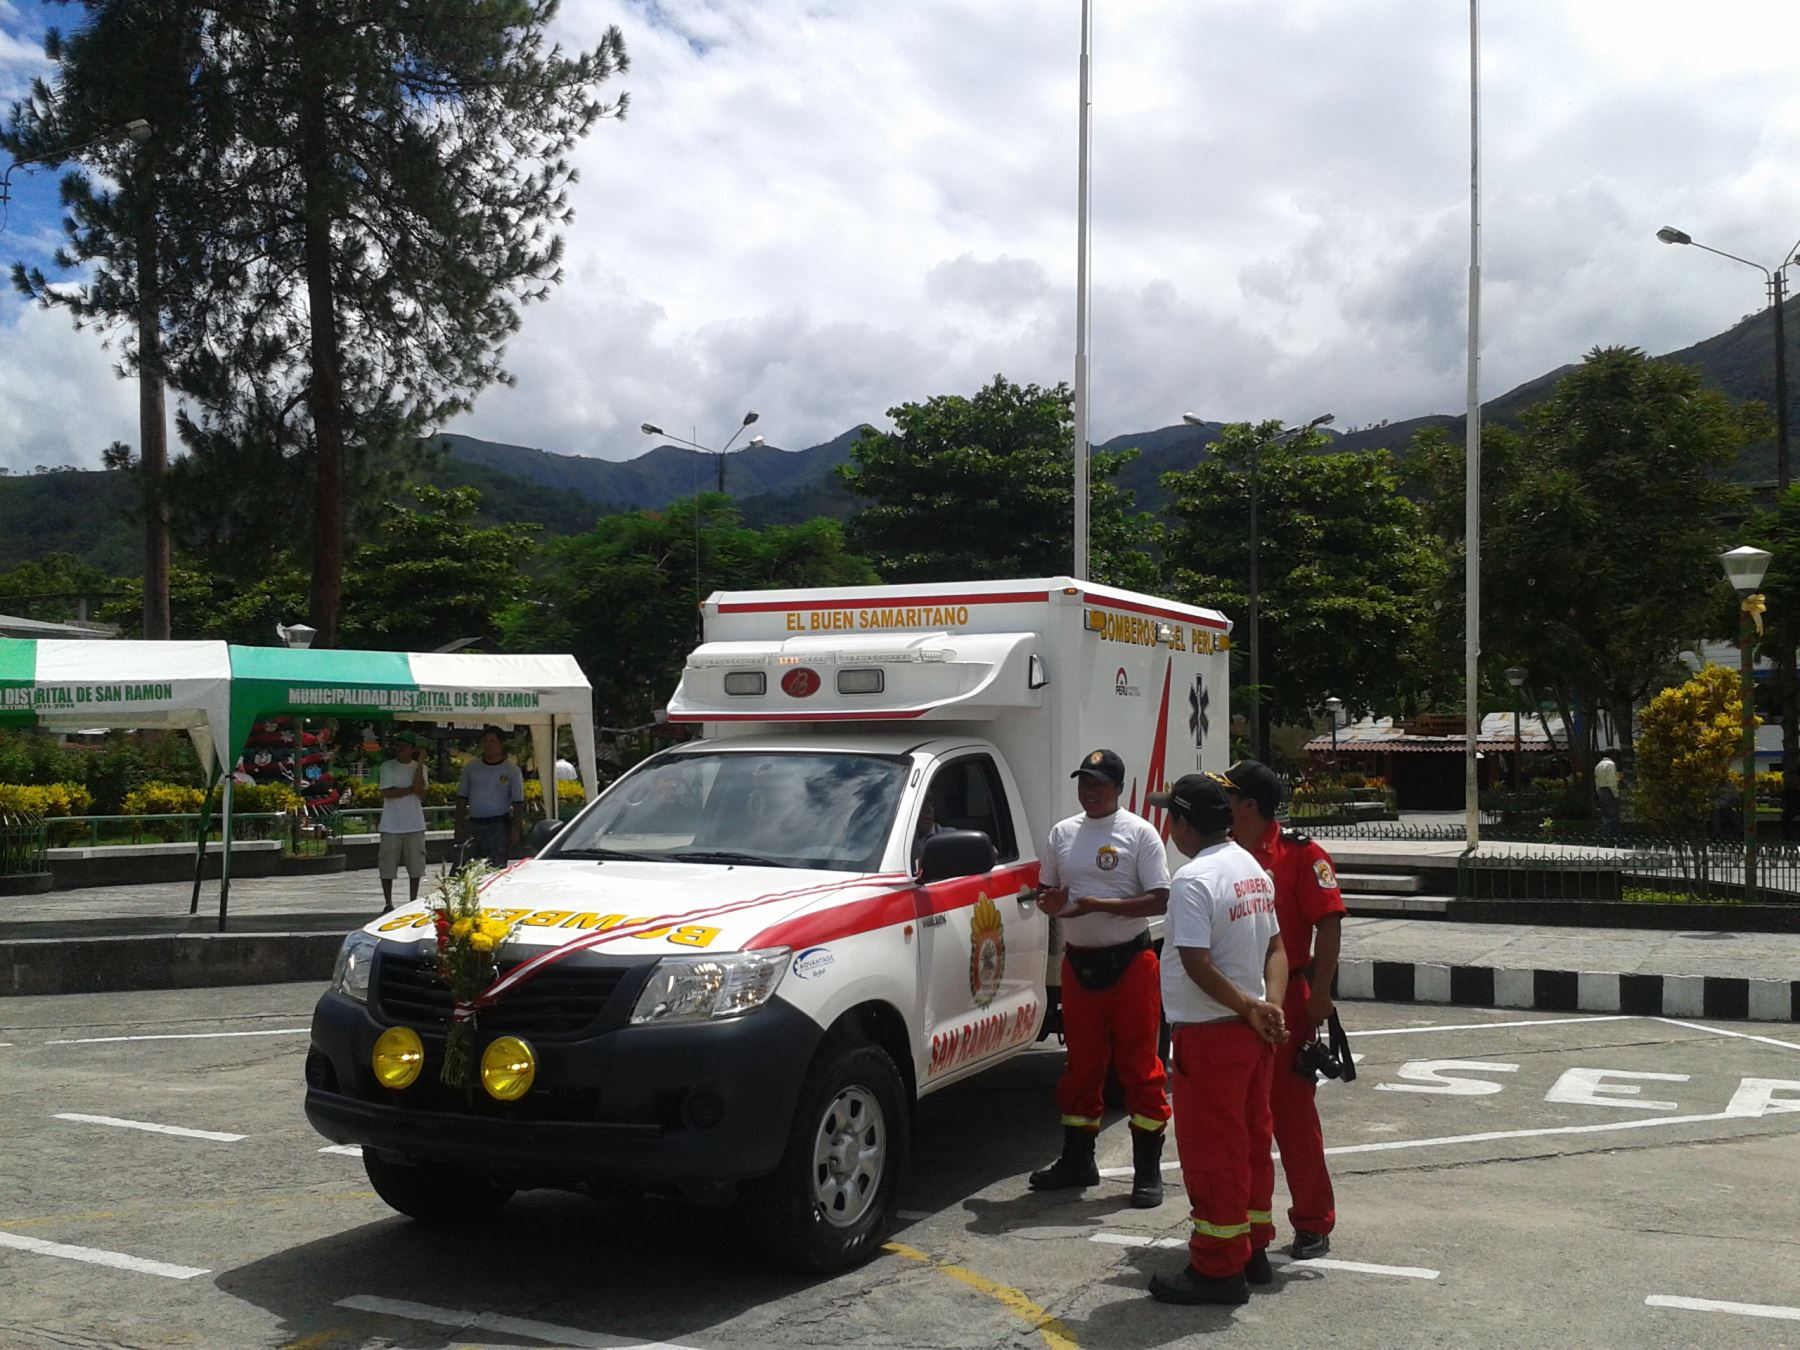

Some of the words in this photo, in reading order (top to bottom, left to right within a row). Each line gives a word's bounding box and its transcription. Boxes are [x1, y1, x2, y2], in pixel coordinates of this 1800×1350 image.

[786, 613, 805, 631] EL
[810, 611, 854, 630] BUEN
[859, 606, 969, 628] SAMARITANO
[5, 687, 74, 705] DISTRITAL
[76, 686, 92, 703] DE
[95, 685, 121, 702] SAN
[125, 683, 172, 700] RAMON
[288, 688, 388, 706] MUNICIPALIDAD
[390, 689, 452, 707] DISTRITAL
[454, 691, 469, 707] DE
[471, 692, 495, 708] SAN
[497, 692, 540, 708] RAMON
[928, 1028, 959, 1076] SAN
[957, 1012, 1007, 1063] RAMON
